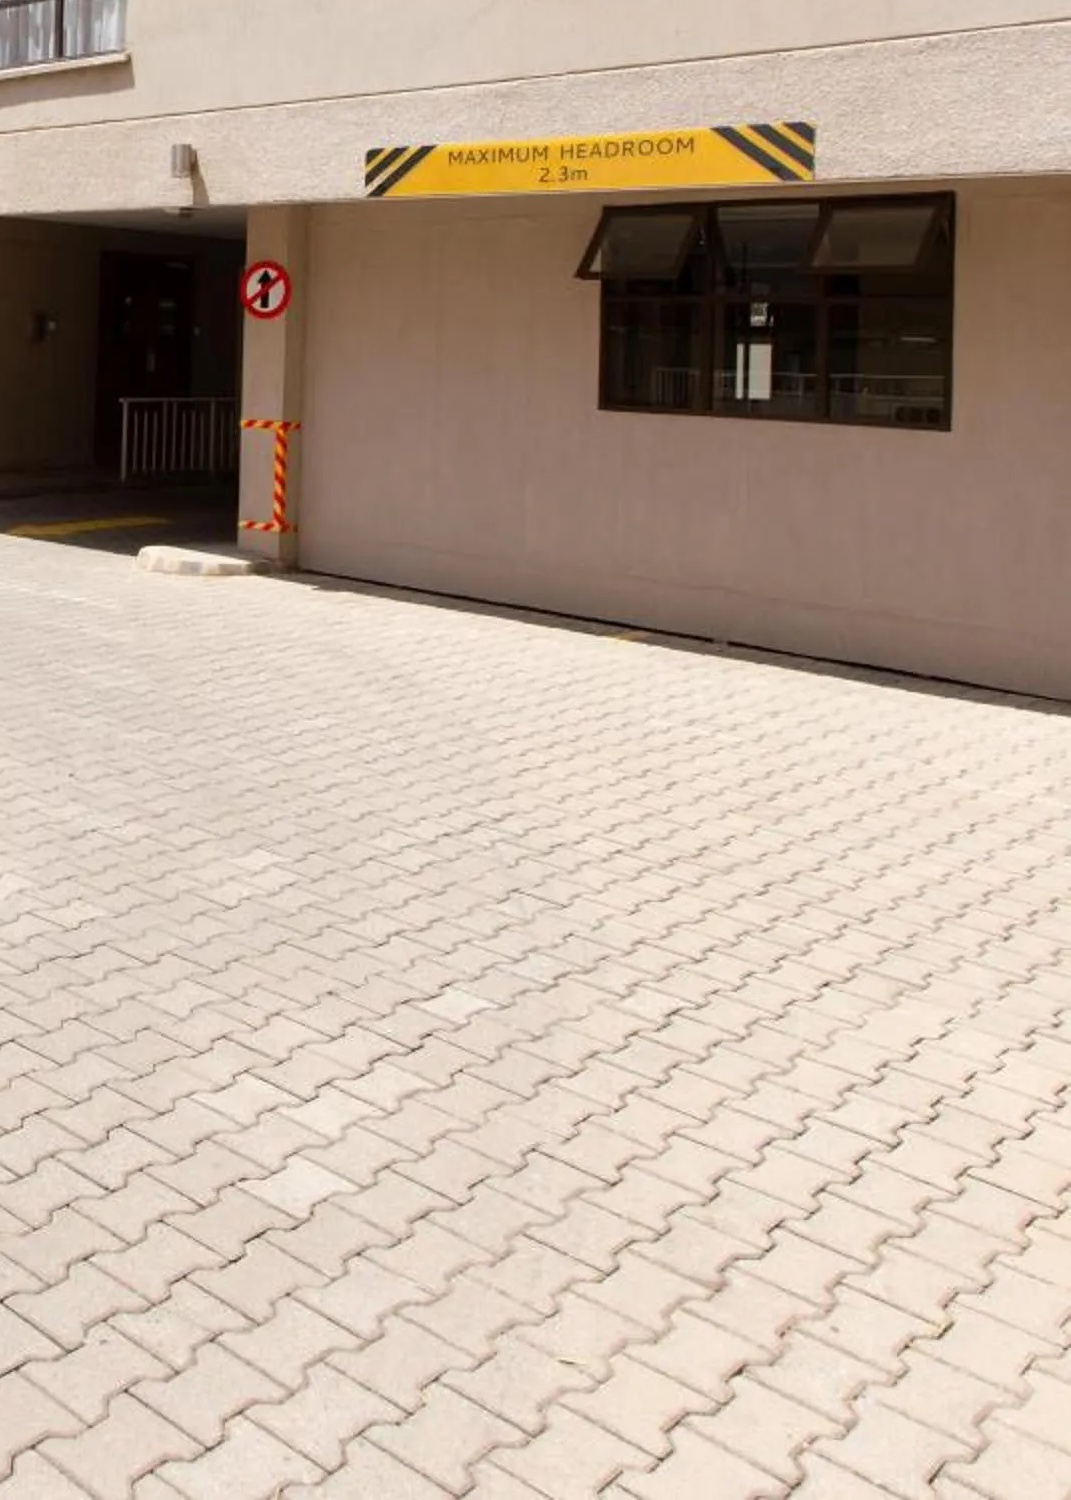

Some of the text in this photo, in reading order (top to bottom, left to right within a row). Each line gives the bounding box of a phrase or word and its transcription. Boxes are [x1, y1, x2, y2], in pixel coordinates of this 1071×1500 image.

[448, 137, 695, 166] MAXIMUM HEADROOM
[539, 166, 588, 183] 2.3m
